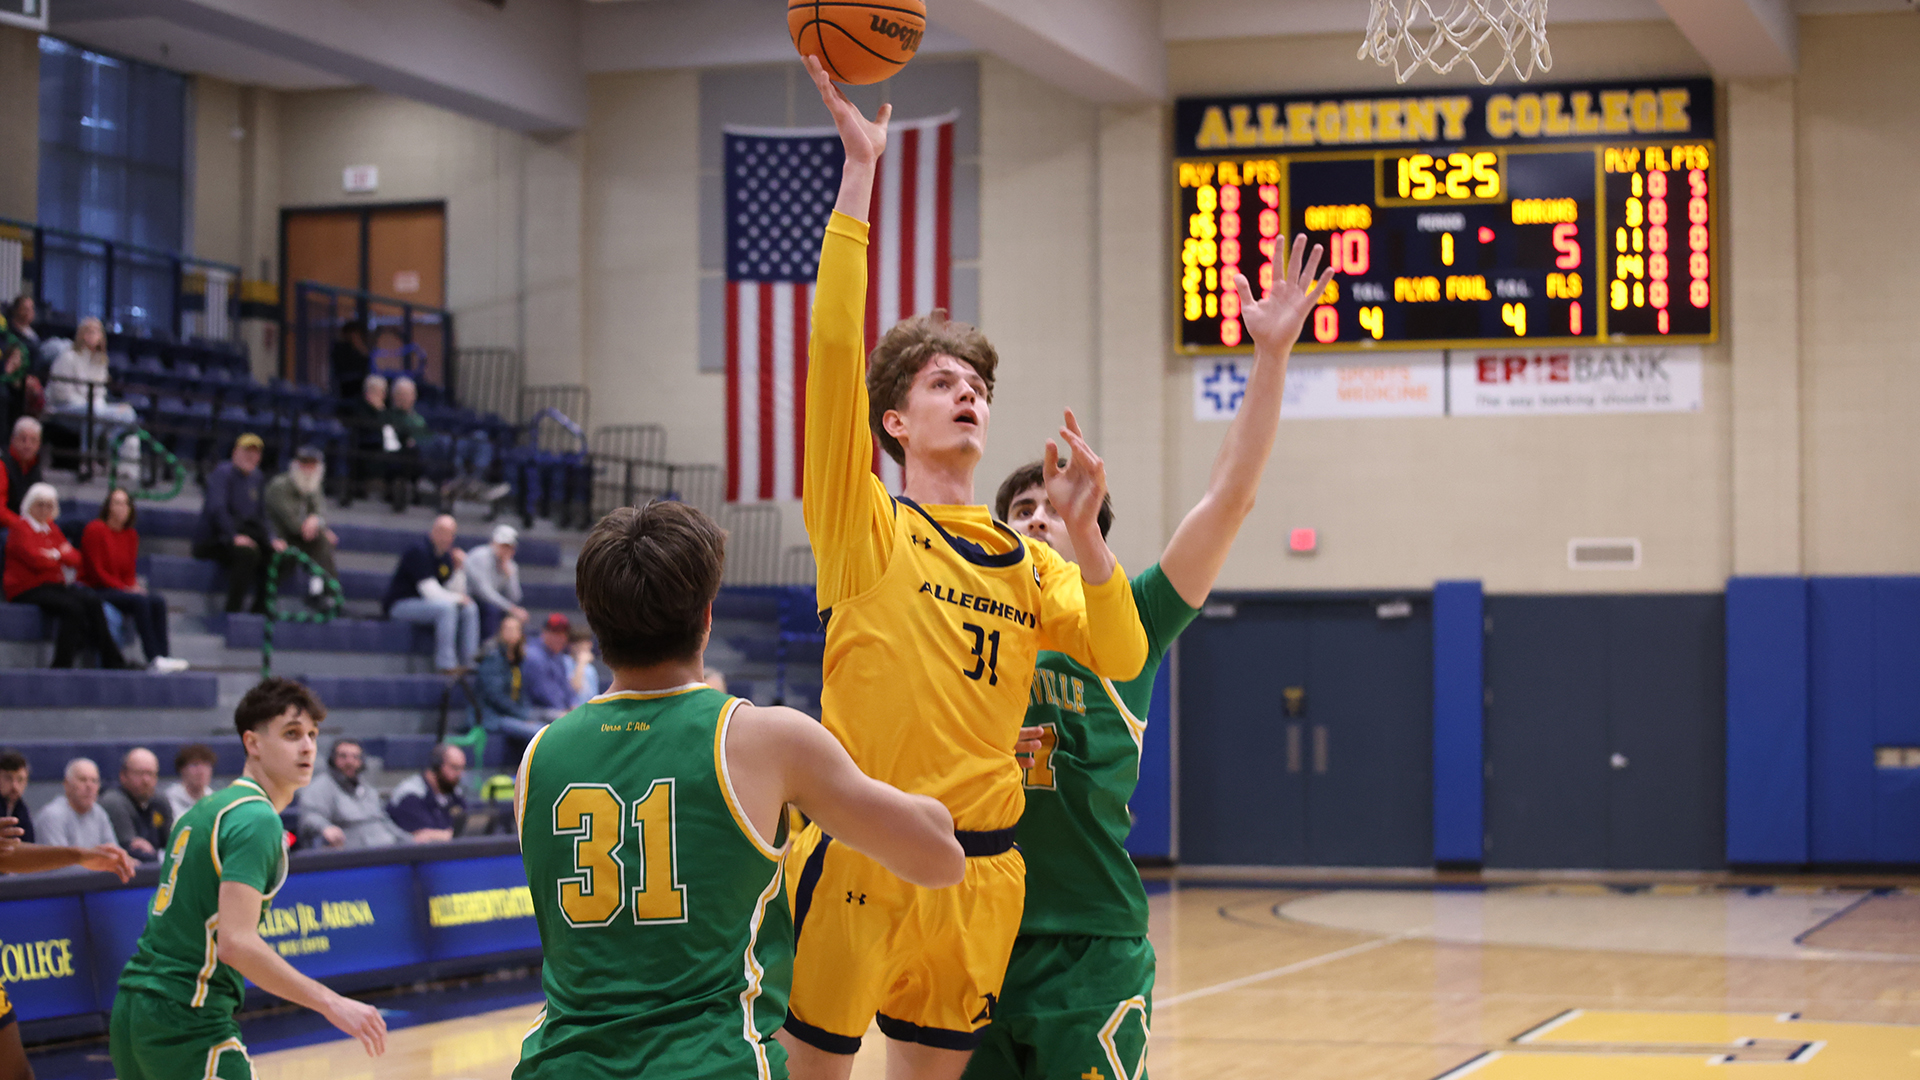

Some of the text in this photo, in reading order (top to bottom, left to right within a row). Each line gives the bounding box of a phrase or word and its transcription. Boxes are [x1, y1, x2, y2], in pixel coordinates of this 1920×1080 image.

[1196, 88, 1690, 149] ALLEGHENY COLLEGE
[1179, 160, 1280, 187] PLY FL PTS
[1605, 145, 1709, 173] PLY FL PTS
[1398, 152, 1499, 200] 15:25
[1631, 168, 1707, 198] 1 0 5
[1220, 184, 1240, 212] 0
[1648, 197, 1667, 226] 0
[1688, 196, 1708, 225] 0
[1220, 211, 1241, 239] 0
[1259, 208, 1279, 237] 0
[1616, 224, 1708, 253] 11 0 0
[1220, 238, 1241, 265] 0
[1330, 229, 1369, 275] 10
[1441, 232, 1454, 266] 1
[1552, 222, 1582, 269] 5
[1616, 251, 1709, 280] 14 0 0
[1446, 275, 1492, 301] FOUL
[1546, 272, 1583, 299] FLS
[1649, 280, 1669, 308] 0
[1690, 278, 1709, 308] 0
[1221, 291, 1241, 319] 0
[1502, 302, 1527, 336] 4
[1569, 301, 1582, 335] 1
[1221, 318, 1241, 346] 0
[1314, 305, 1339, 343] 0
[1359, 306, 1384, 340] 4
[1657, 308, 1669, 334] 1
[963, 622, 1000, 686] 31
[552, 777, 688, 929] 31
